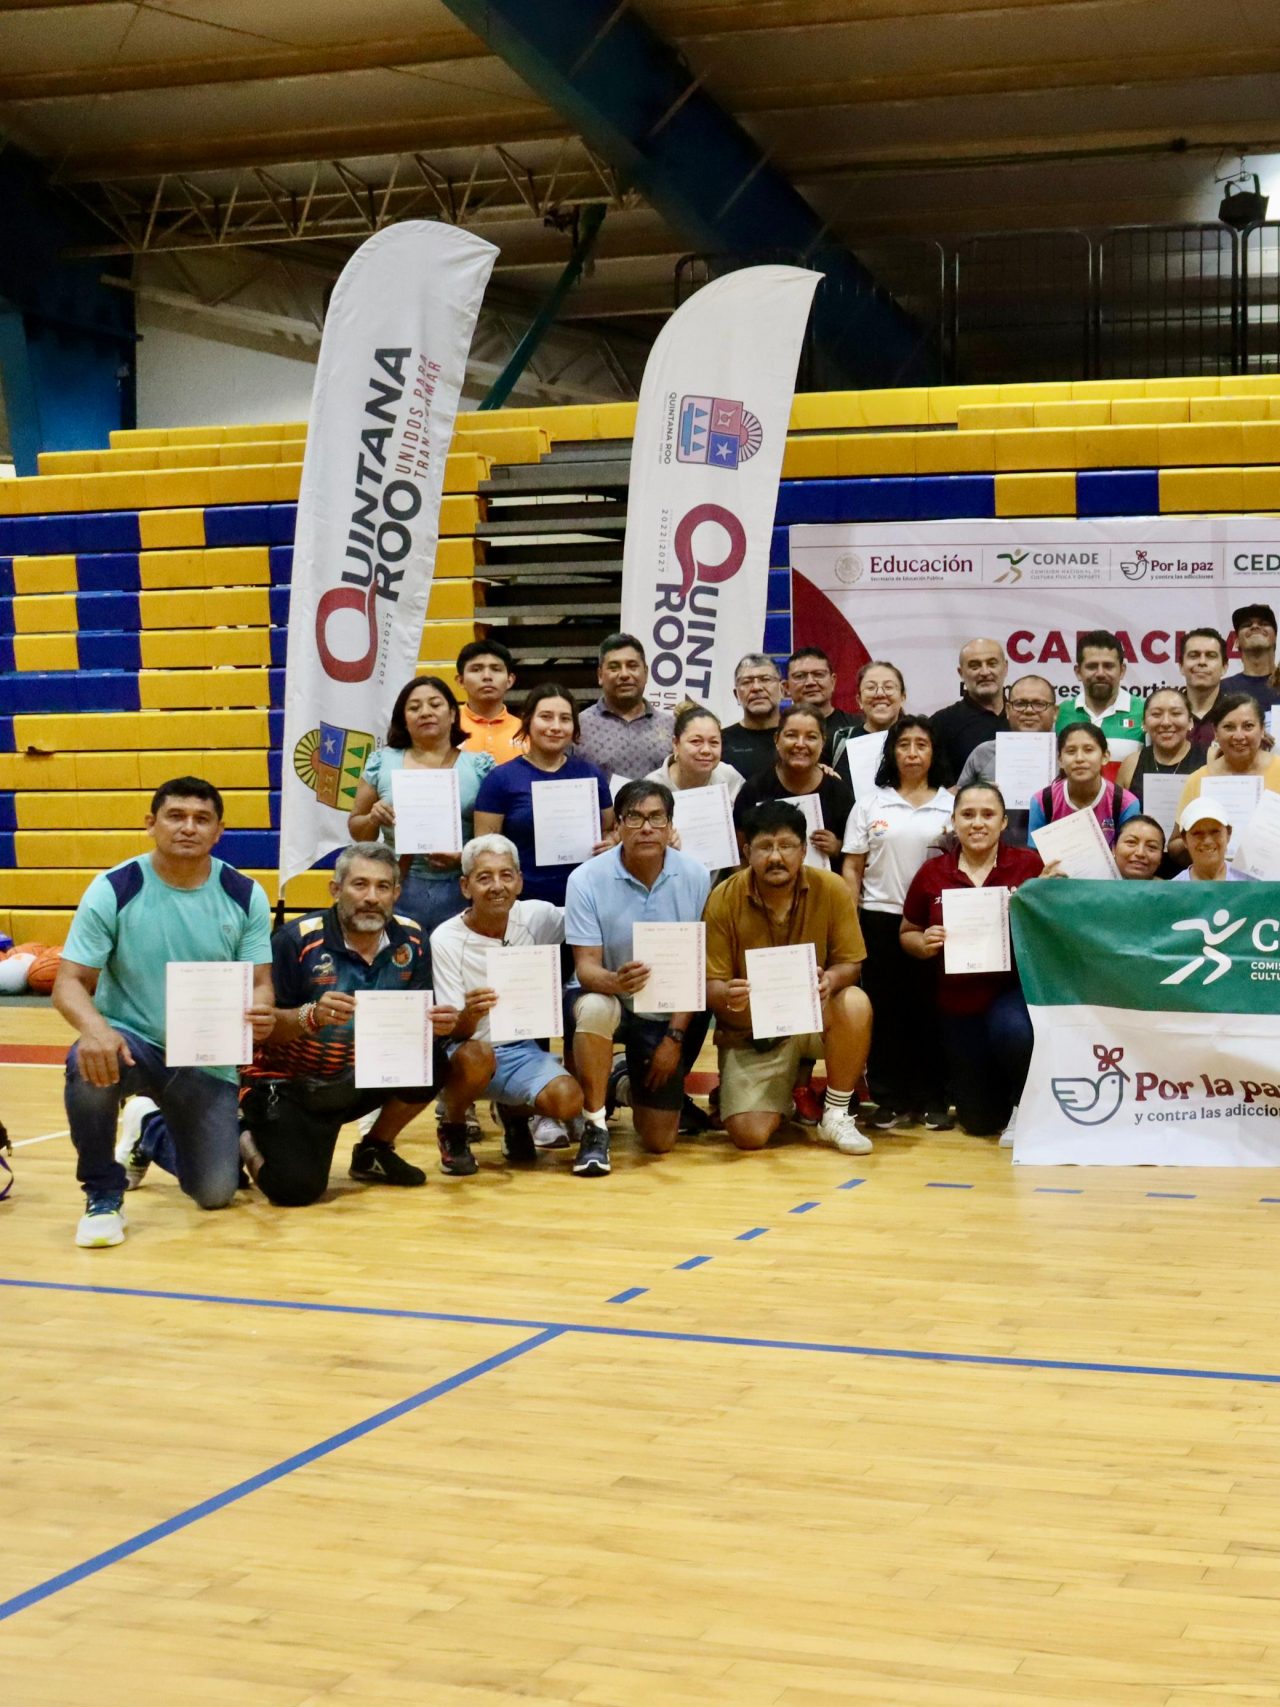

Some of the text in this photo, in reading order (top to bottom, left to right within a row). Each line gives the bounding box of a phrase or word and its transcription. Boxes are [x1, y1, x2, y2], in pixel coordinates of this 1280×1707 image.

[395, 406, 424, 476] UNIDOS
[664, 391, 677, 465] QUINTANA ROO
[315, 347, 413, 684] QUINTANA
[374, 479, 422, 603] ROO
[870, 554, 974, 574] Educación
[1033, 552, 1099, 566] CONADE
[1151, 559, 1214, 574] Por la paz
[651, 583, 687, 688] ROO
[1135, 1072, 1195, 1102] Por
[1200, 1073, 1235, 1098] la
[1134, 1110, 1144, 1125] y
[1146, 1107, 1197, 1122] contra
[1200, 1106, 1221, 1119] las
